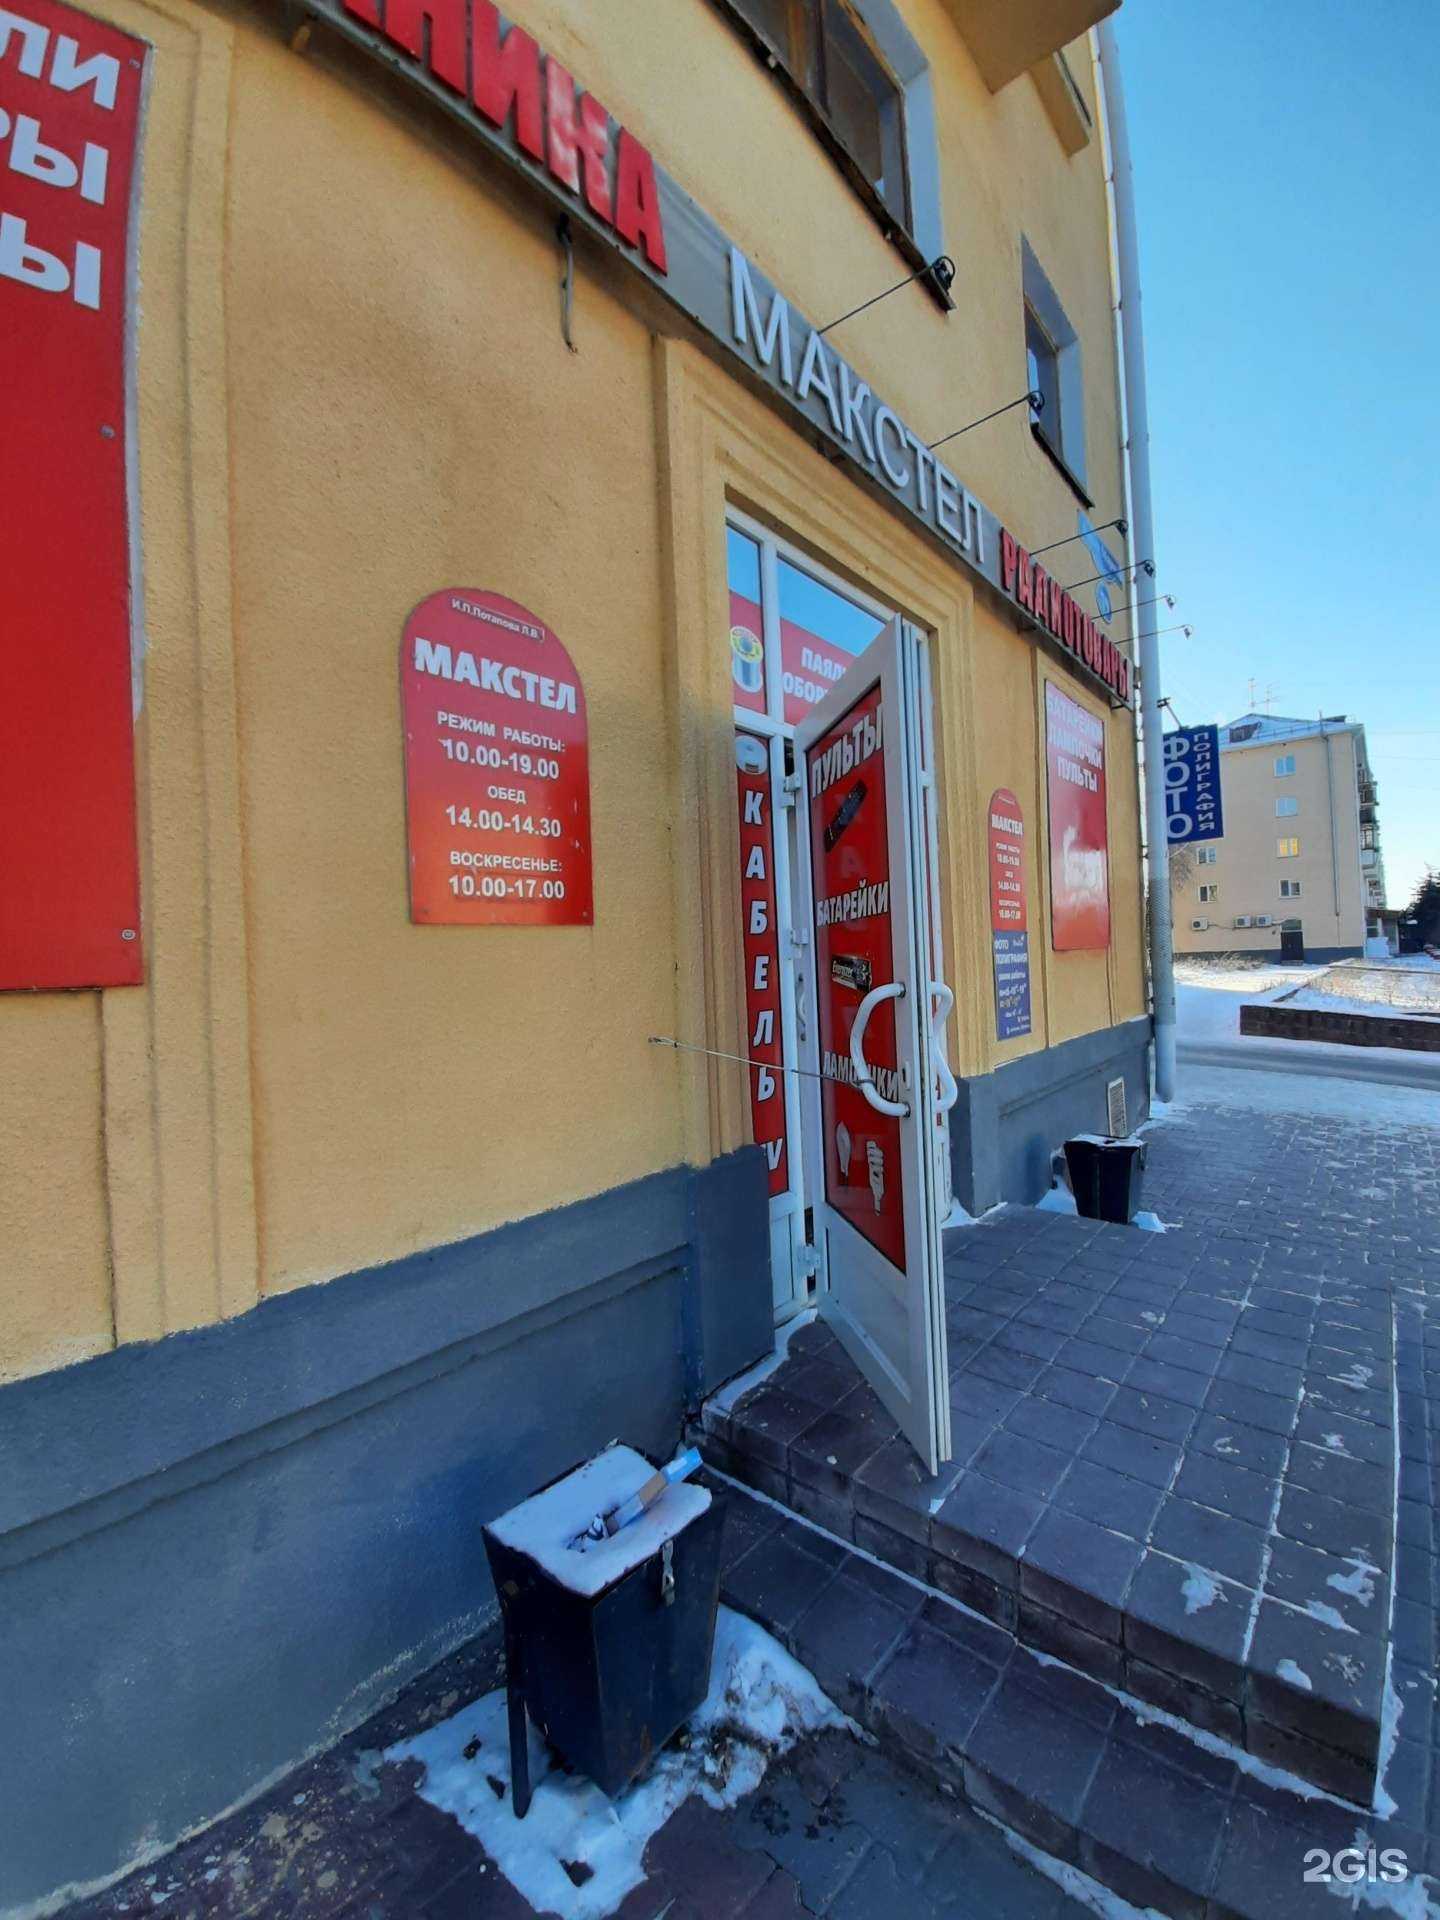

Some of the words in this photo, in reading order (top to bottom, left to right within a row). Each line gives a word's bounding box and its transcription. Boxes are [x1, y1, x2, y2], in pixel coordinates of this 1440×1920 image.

[0, 107, 109, 205] Ы
[728, 247, 985, 564] МАКСТЕЛ
[1001, 527, 1129, 702] РАДИОТОВАРЫ
[414, 636, 577, 715] МАКСТЕЛ
[801, 647, 847, 682] ПАЯЛ
[783, 672, 829, 704] ОБОР
[437, 711, 496, 737] РЕЖИМ
[503, 727, 566, 752] РАБОТЫ:
[812, 704, 884, 800] ПУЛЬТЫ
[442, 738, 560, 779] 10.00-19.00
[1057, 756, 1098, 792] ПУЛЬТЫ
[487, 785, 526, 804] ОБЕД
[1163, 735, 1193, 839] ФОТО
[1193, 732, 1215, 831] ПОЛИГРАФИЯ
[446, 806, 561, 838] 14.00-14.30
[450, 851, 562, 872] ВОСКРЕСЕНЬЕ:
[449, 875, 565, 899] 10.00-17.00
[816, 879, 889, 926] БАТАРЕЙКИ
